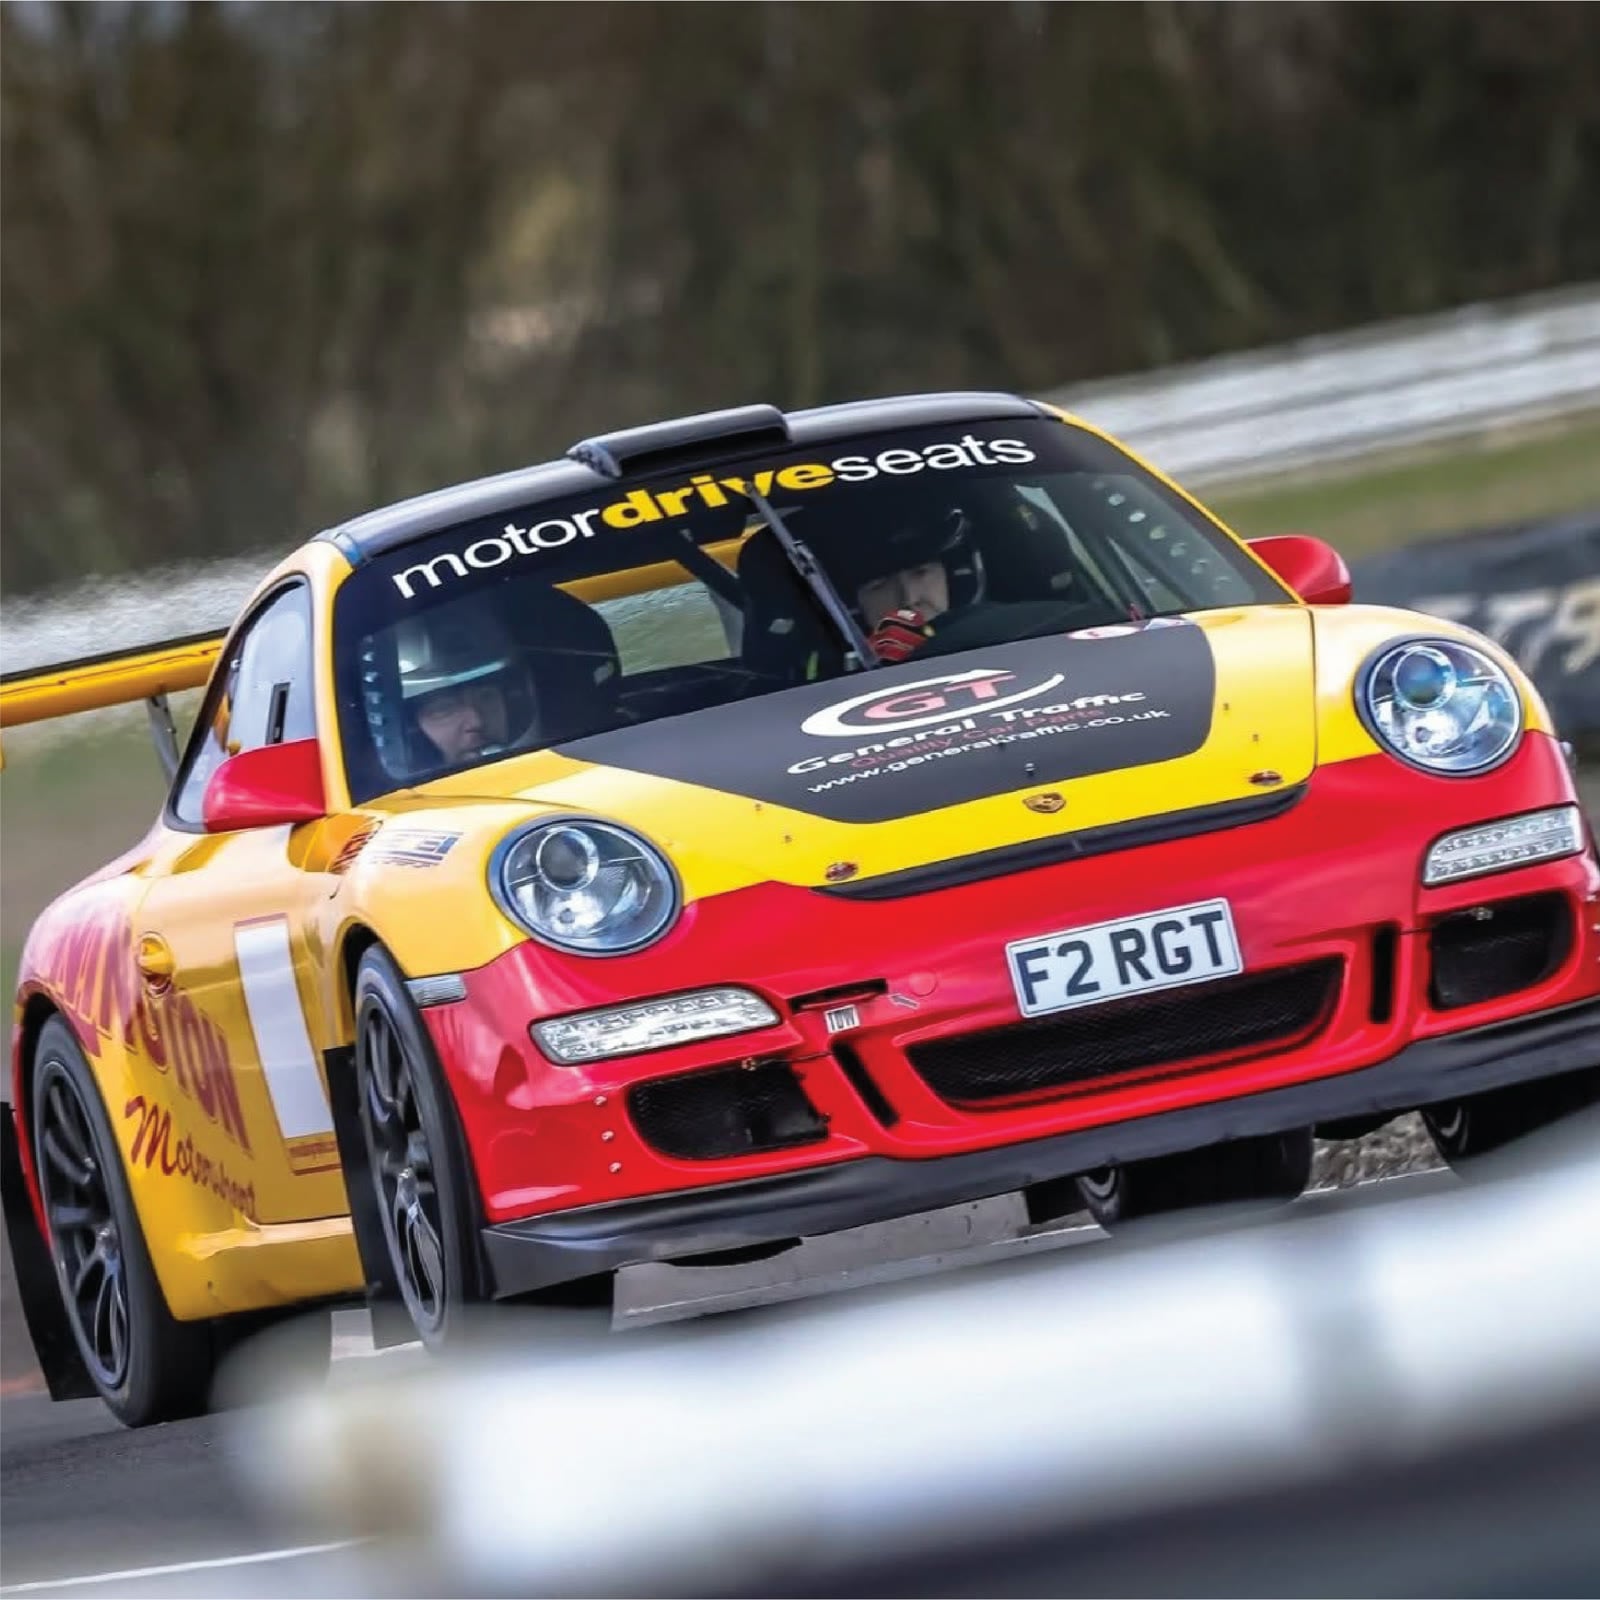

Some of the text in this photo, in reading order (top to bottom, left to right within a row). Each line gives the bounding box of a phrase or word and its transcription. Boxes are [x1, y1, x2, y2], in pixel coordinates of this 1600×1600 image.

[392, 435, 1035, 599] motordriveseats
[787, 691, 1146, 775] General Traffic
[863, 675, 1017, 719] GT
[850, 734, 954, 768] Quality
[1015, 910, 1224, 1006] F2 RGT
